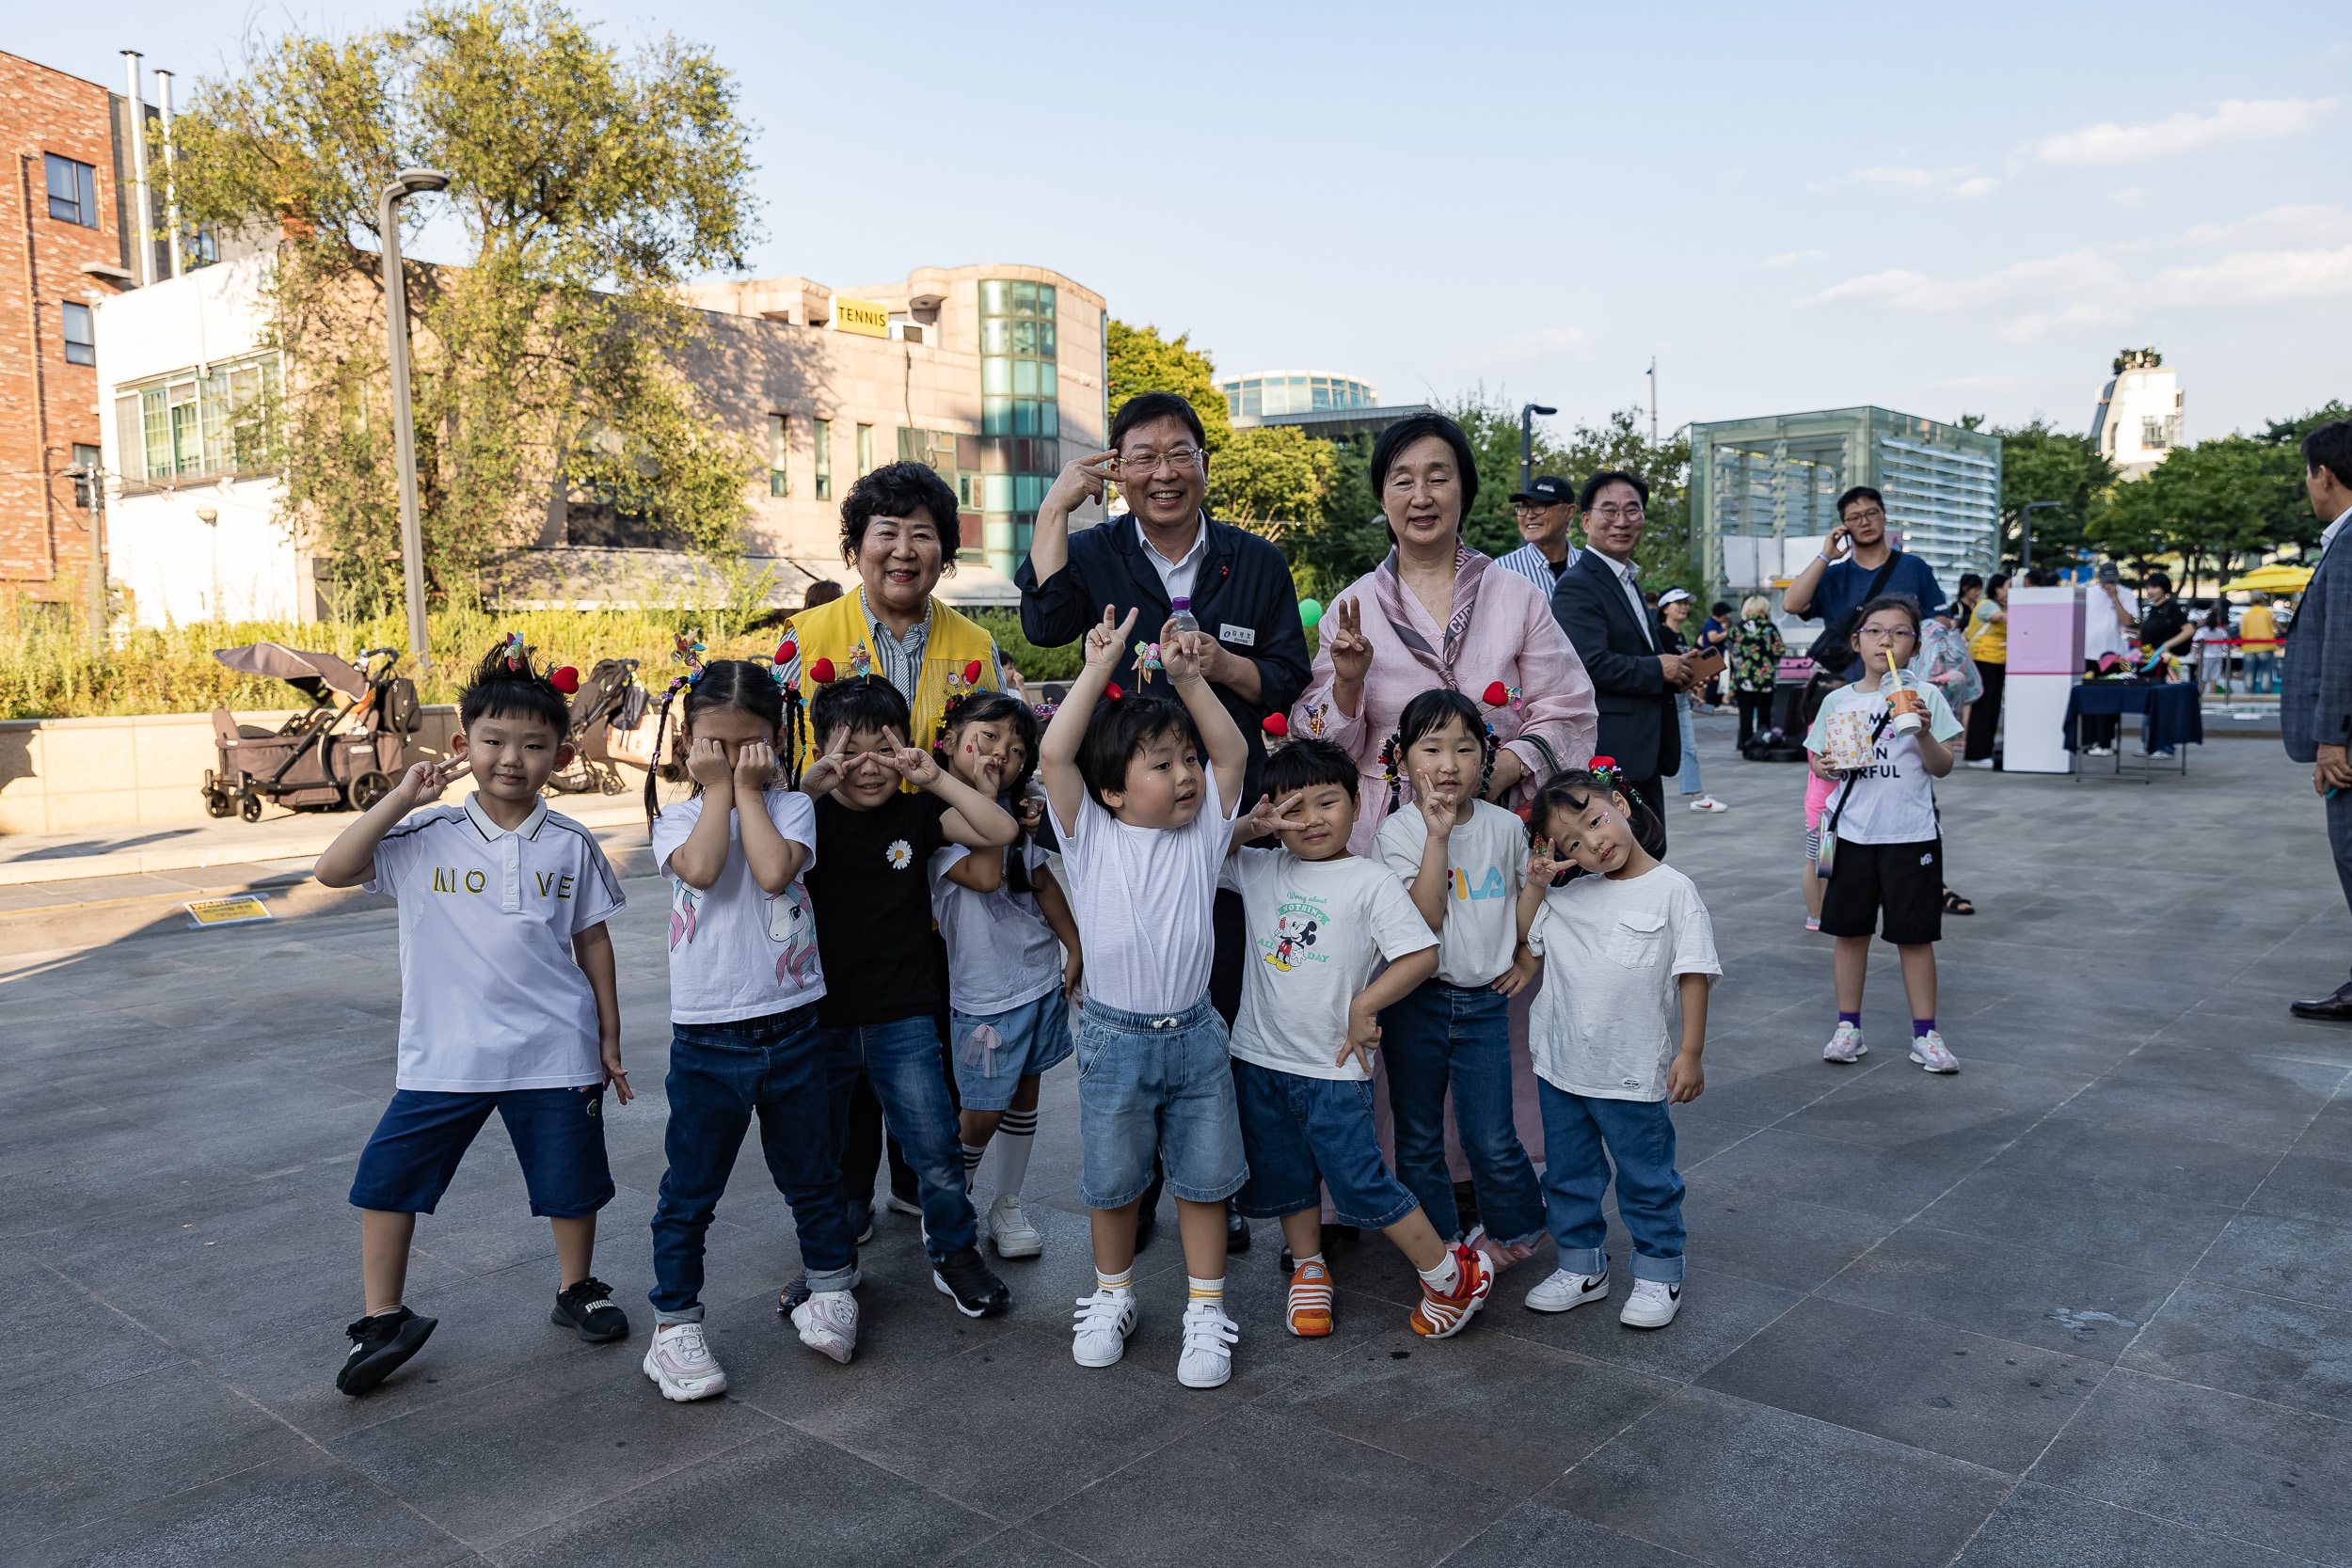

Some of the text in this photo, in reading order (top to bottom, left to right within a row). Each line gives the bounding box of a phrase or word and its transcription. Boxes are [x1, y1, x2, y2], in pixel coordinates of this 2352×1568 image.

[838, 307, 886, 327] TENNIS
[1286, 891, 1327, 904] Worry about
[1282, 904, 1323, 921] NOTHING
[1257, 938, 1329, 963] ALL DAY
[680, 1325, 702, 1335] FILA
